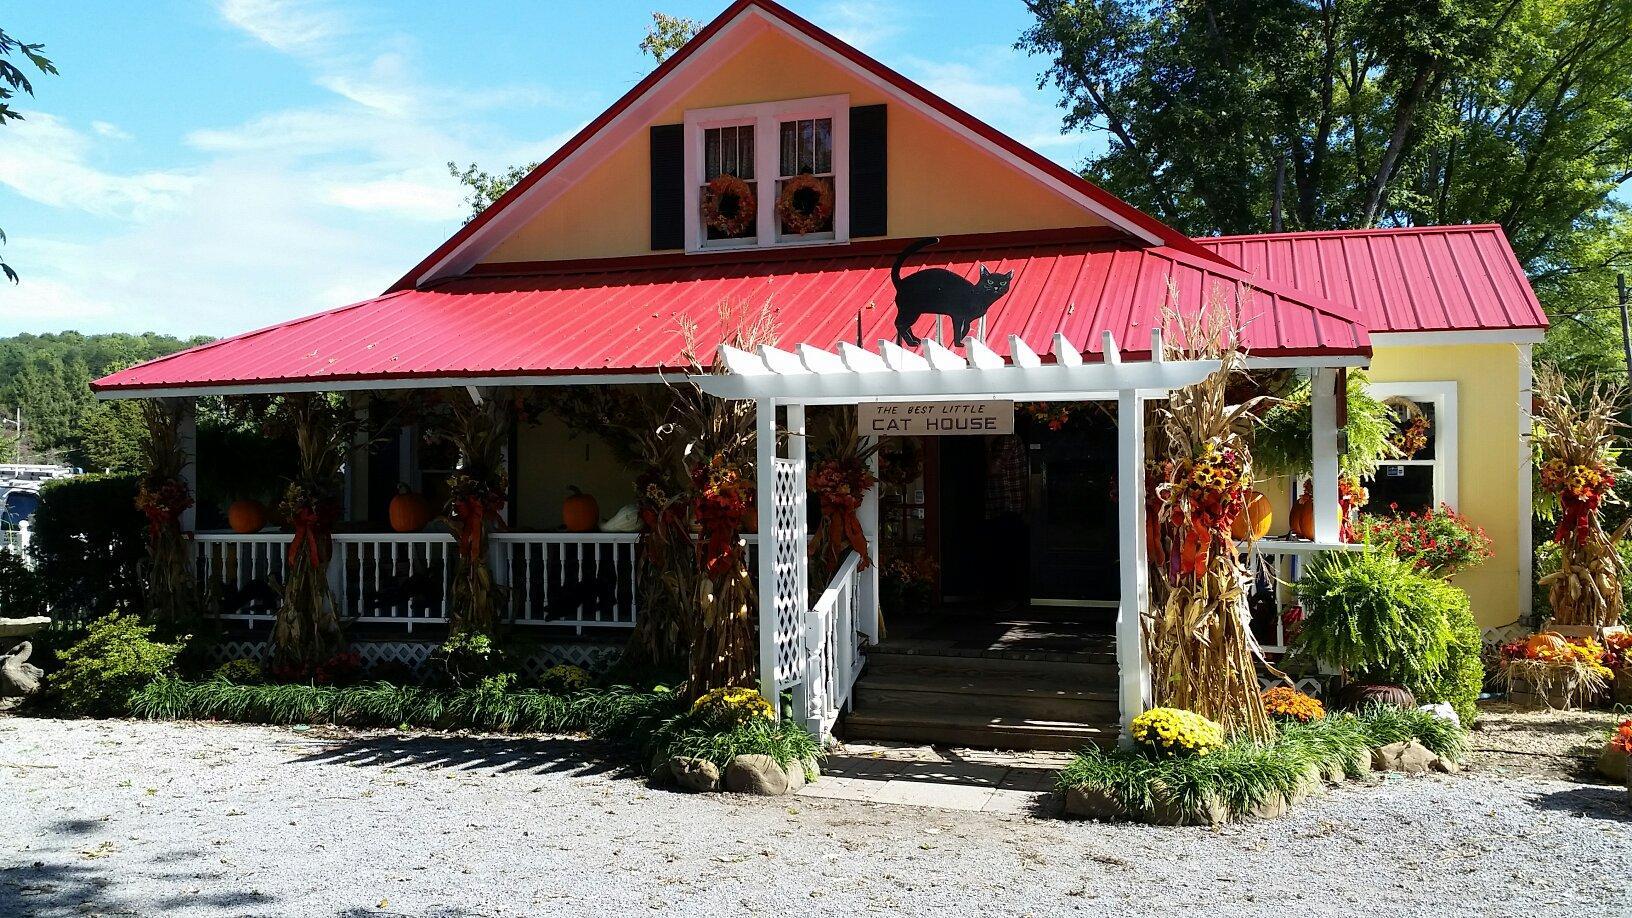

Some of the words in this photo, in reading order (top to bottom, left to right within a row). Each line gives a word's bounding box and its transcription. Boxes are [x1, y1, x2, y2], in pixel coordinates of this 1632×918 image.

[877, 406, 898, 414] THE
[907, 405, 934, 414] BEST
[942, 404, 985, 414] LITTLE
[872, 418, 912, 431] CAT
[926, 417, 997, 431] HOUSE
